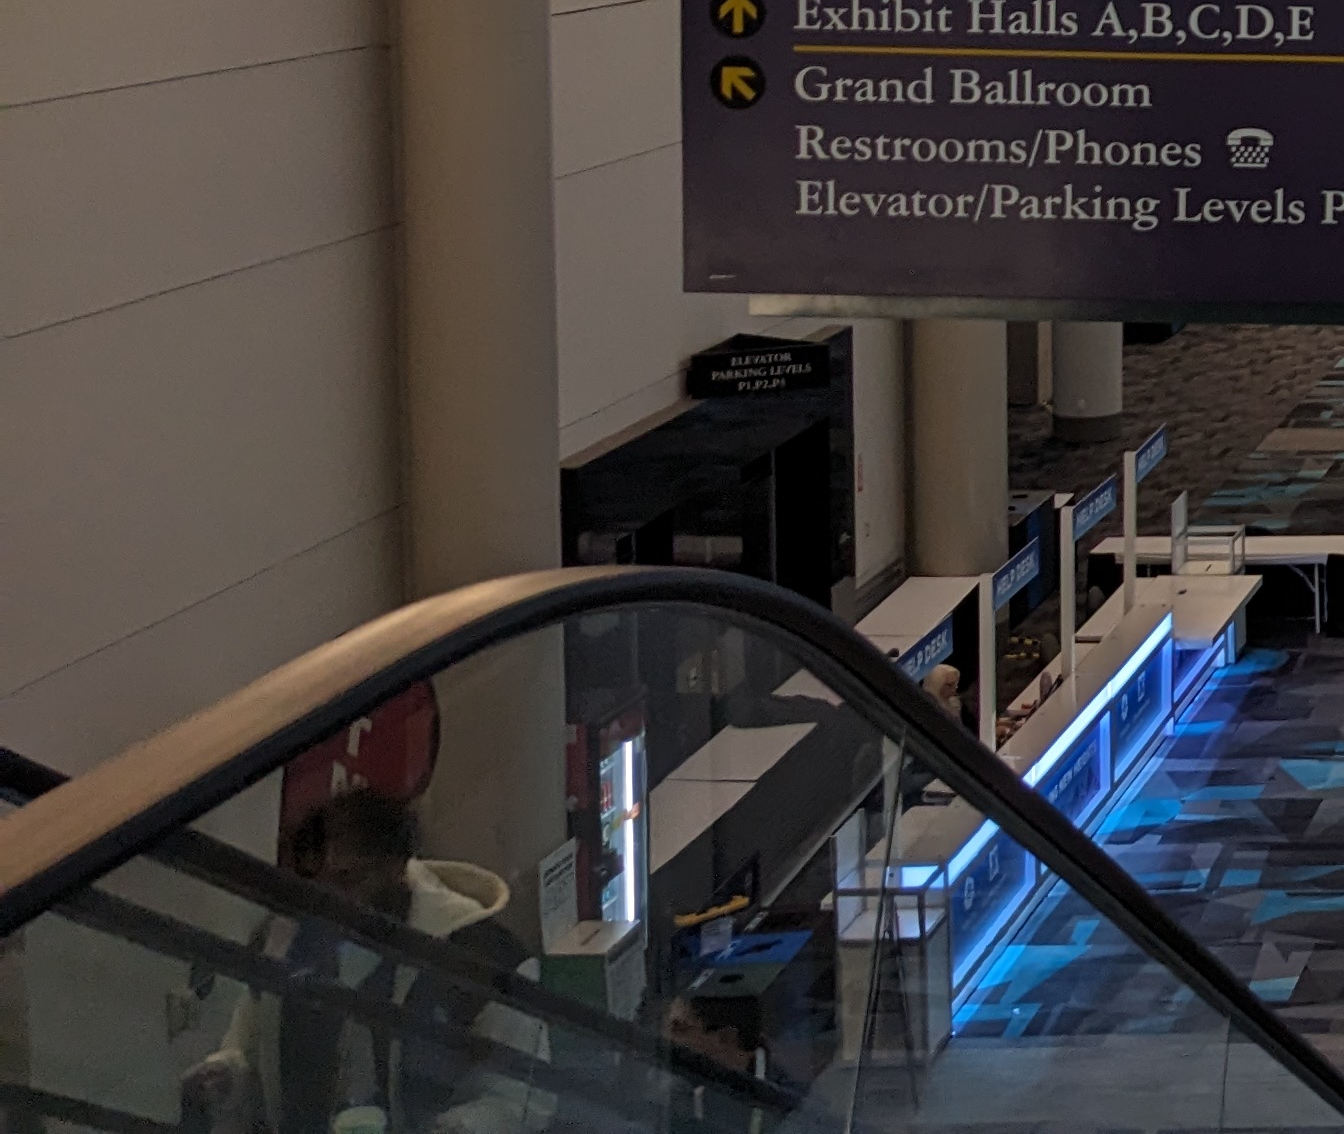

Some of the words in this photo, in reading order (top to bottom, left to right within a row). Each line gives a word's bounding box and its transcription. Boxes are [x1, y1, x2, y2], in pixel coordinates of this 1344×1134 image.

[967, 0, 1078, 37] Halls
[1092, 4, 1315, 44] A,B,C,D,E
[794, 66, 934, 105] Grand
[950, 69, 1152, 109] Ballroom
[795, 126, 1202, 168] Restrooms/Phones
[795, 180, 1160, 231] Elevator/Parking
[1174, 187, 1306, 226] Levels
[711, 367, 767, 380] PARKING
[769, 362, 812, 375] LEVELS
[730, 352, 792, 366] ELEVATOR
[925, 629, 948, 665] DESK
